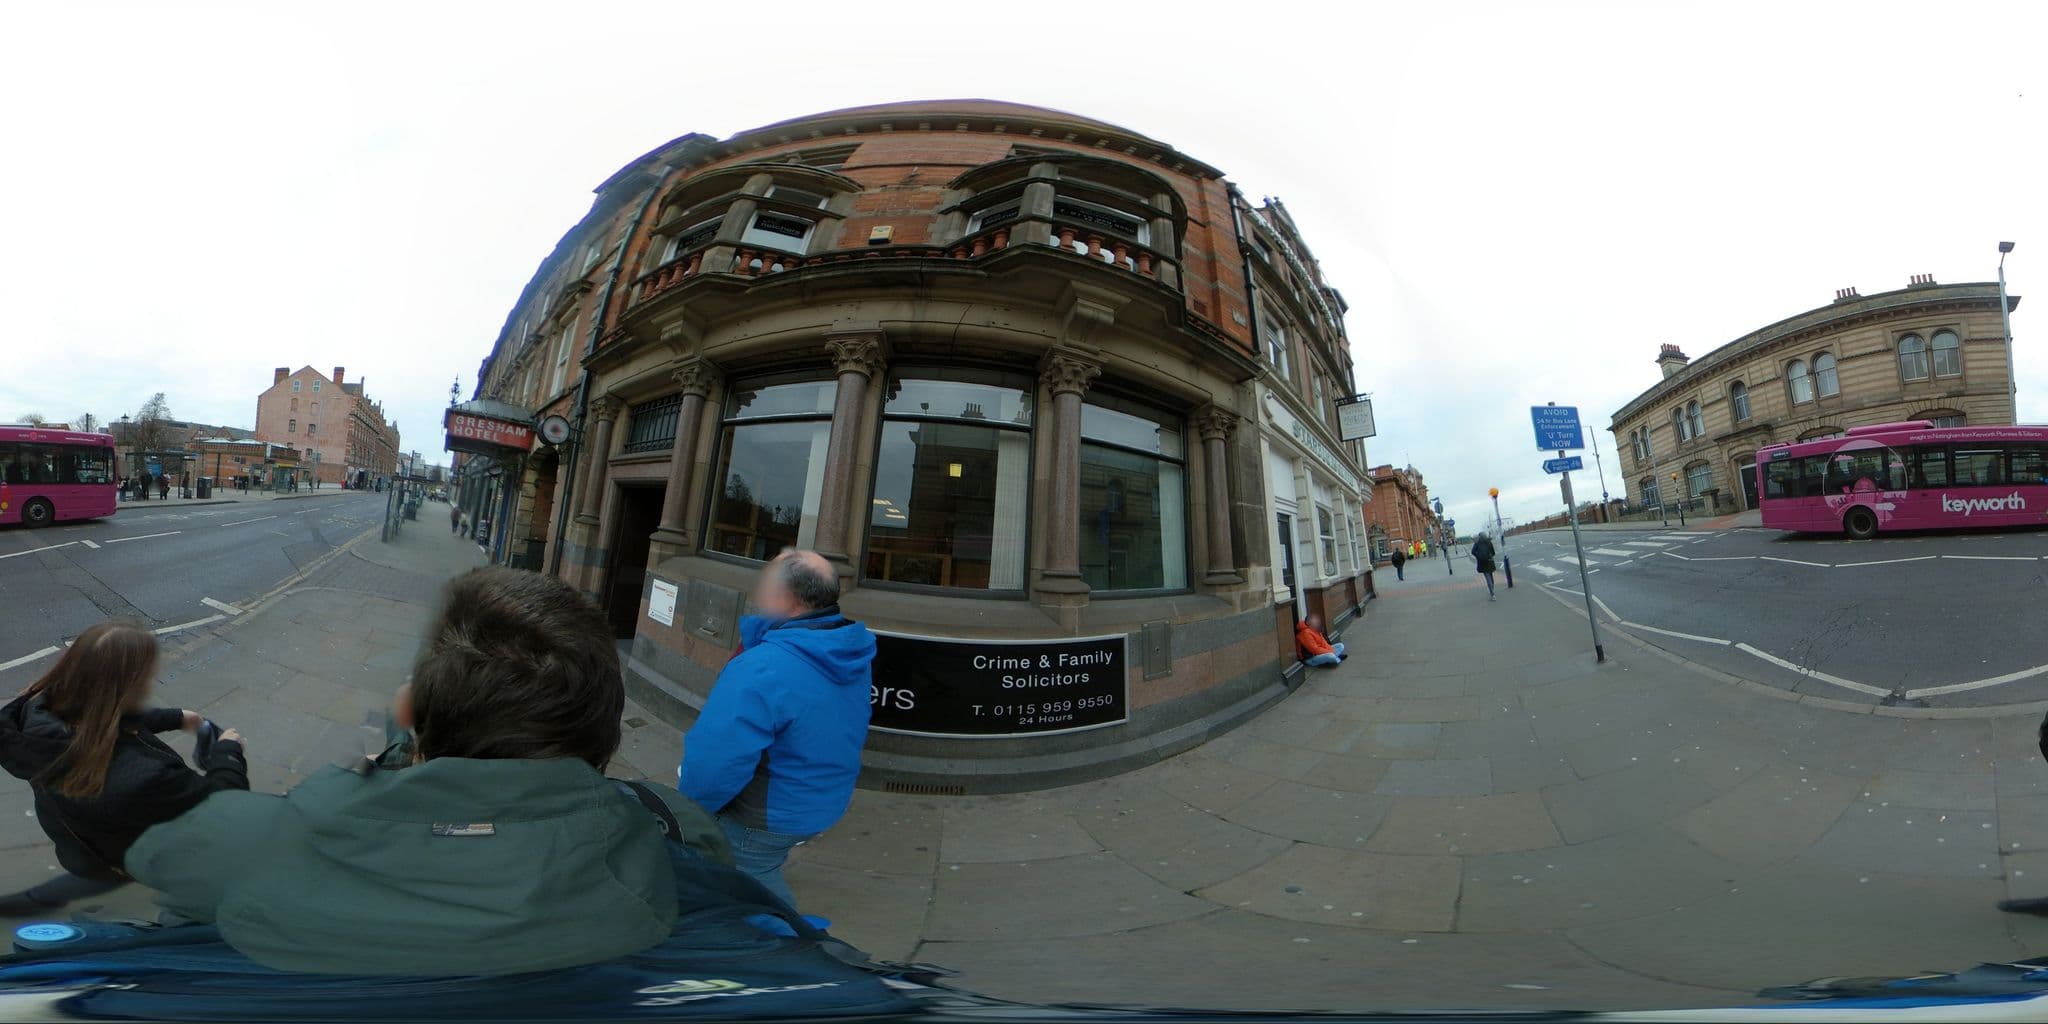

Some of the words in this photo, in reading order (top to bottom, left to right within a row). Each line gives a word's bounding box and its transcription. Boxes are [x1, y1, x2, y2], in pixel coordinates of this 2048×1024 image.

[453, 425, 498, 442] HOTEL
[455, 416, 527, 437] GRESHAM
[1557, 431, 1574, 439] Turn
[1942, 491, 2026, 516] keyworth
[973, 655, 1030, 669] Crime
[1039, 654, 1051, 668] &
[1059, 650, 1113, 665] Family
[1001, 672, 1090, 689] Solicitors
[972, 704, 985, 716] T.
[994, 703, 1036, 716] 0115
[1042, 700, 1072, 714] 959
[1077, 694, 1113, 709] 9550
[1019, 716, 1033, 725] 24
[1038, 713, 1073, 724] Hours
